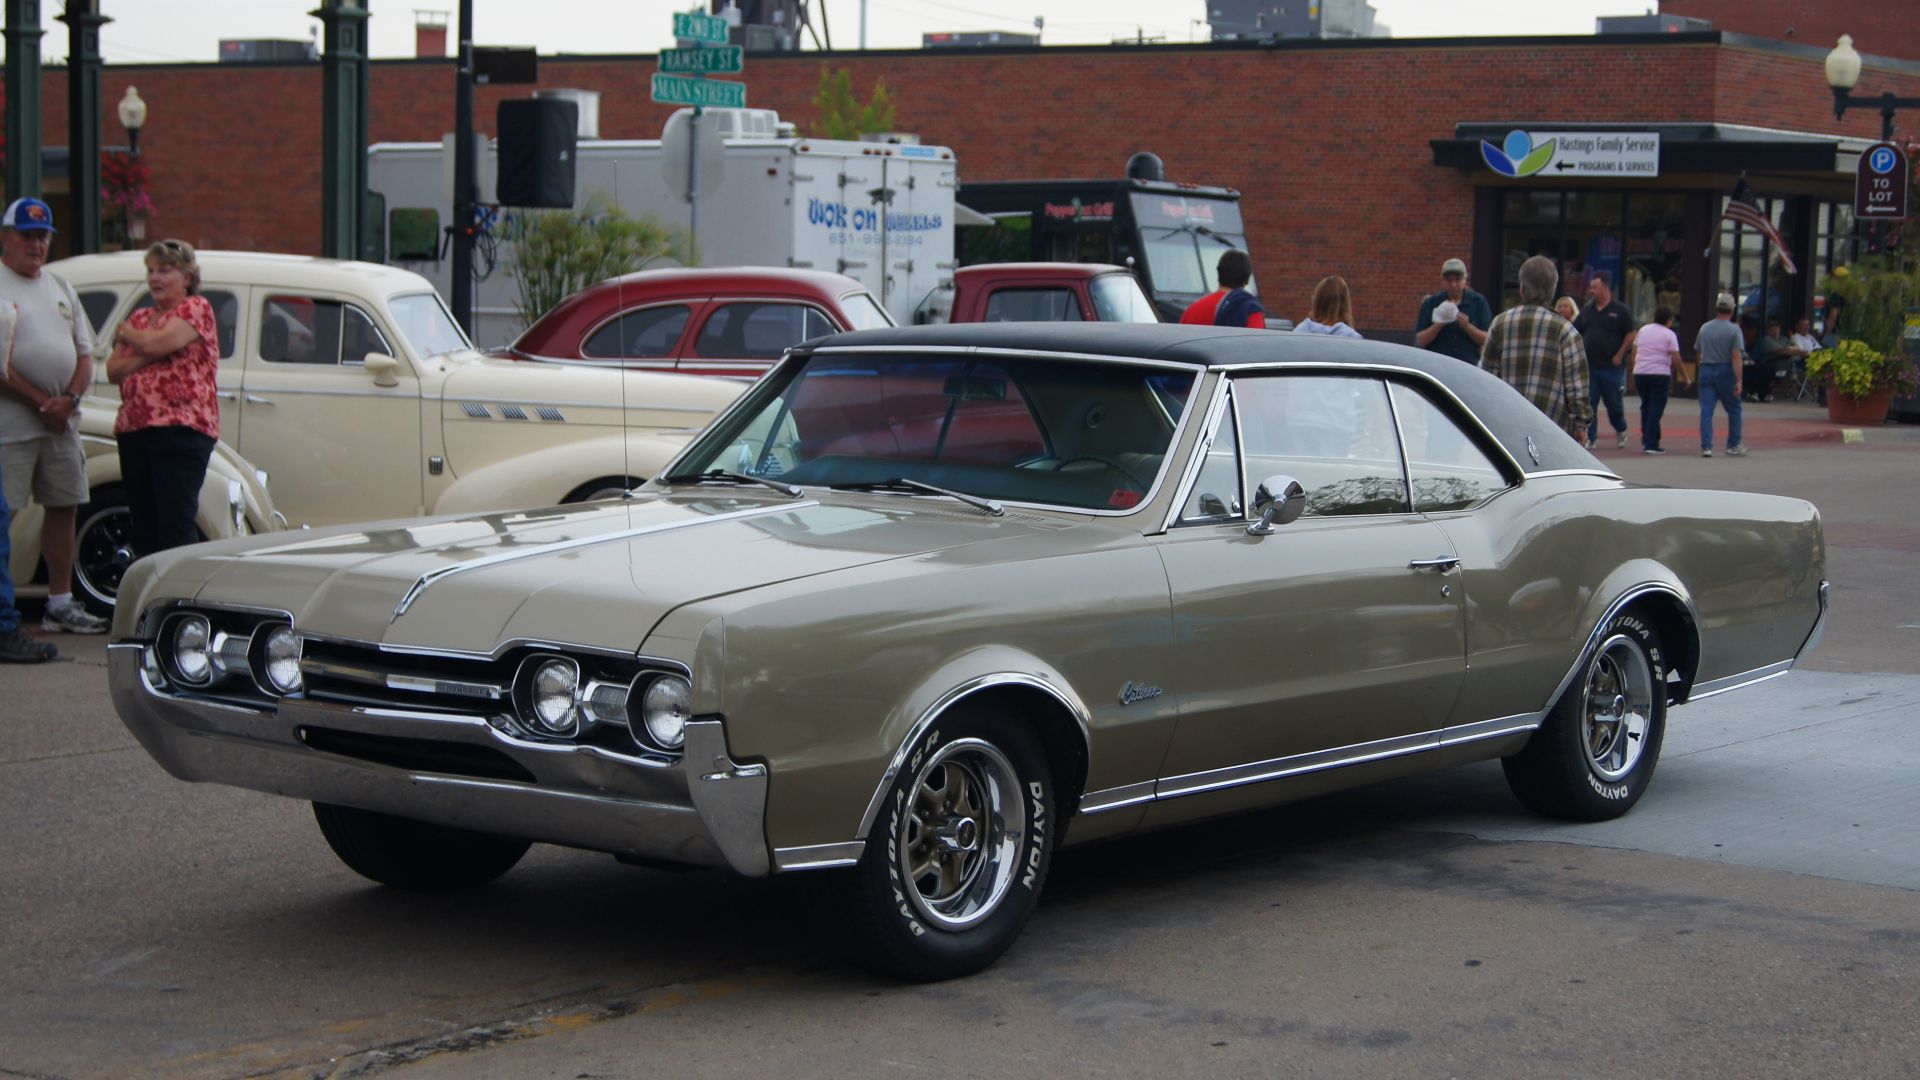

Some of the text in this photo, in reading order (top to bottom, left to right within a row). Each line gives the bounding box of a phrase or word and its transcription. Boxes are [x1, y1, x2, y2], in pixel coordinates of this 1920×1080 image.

[678, 15, 724, 40] E 2ND ST
[665, 50, 732, 69] RAMSEY ST
[656, 78, 740, 105] MAIN STREET
[1559, 137, 1655, 154] Hastings Family Service
[1579, 161, 1616, 171] PROGRAMS
[1625, 161, 1655, 171] SERVICES
[1873, 178, 1890, 189] TO
[1868, 192, 1893, 202] LOT
[1587, 773, 1629, 800] DAYTON
[1021, 781, 1044, 891] DAYTON
[887, 787, 926, 937] DAYTONA
